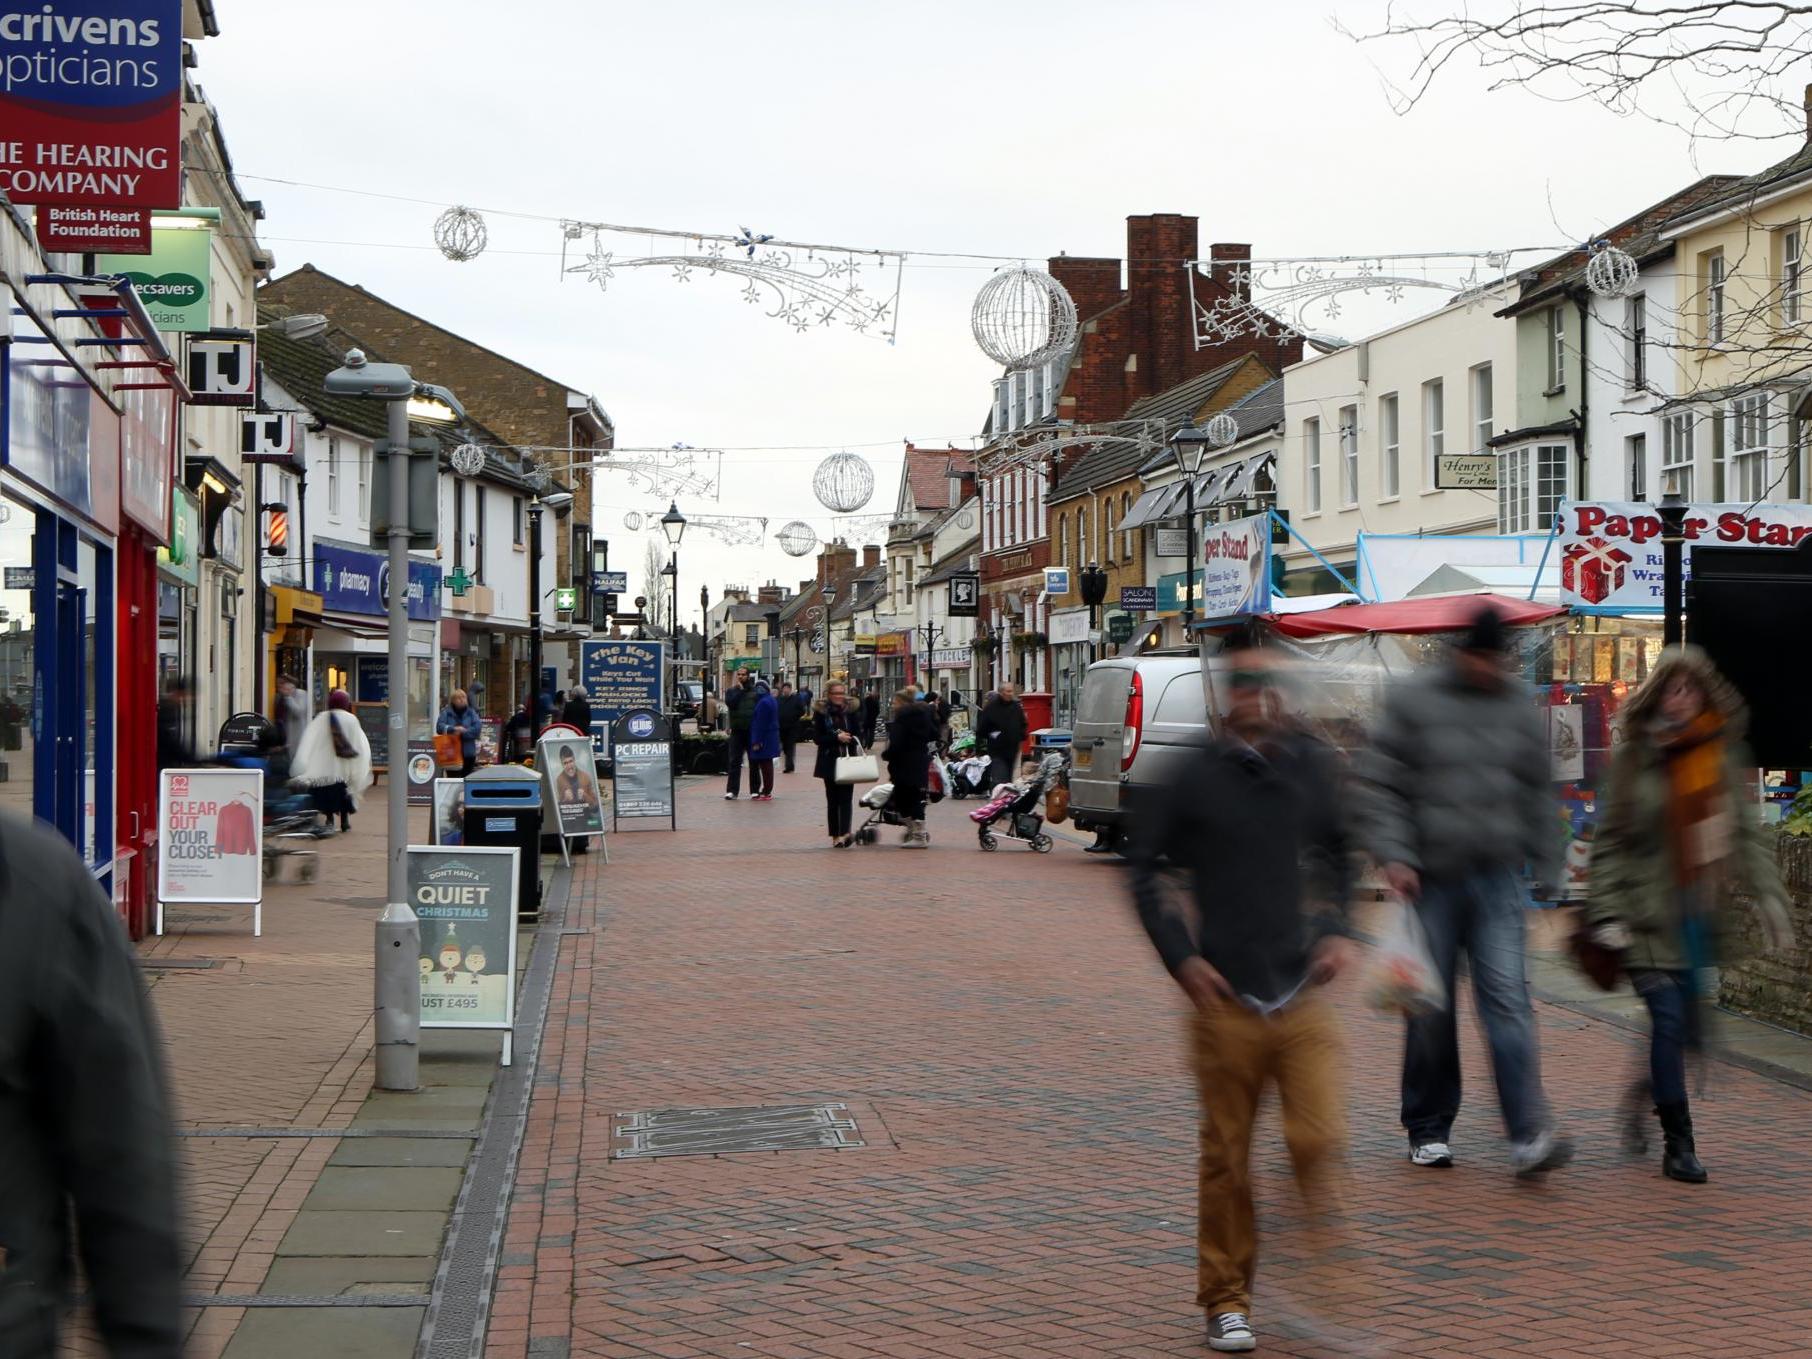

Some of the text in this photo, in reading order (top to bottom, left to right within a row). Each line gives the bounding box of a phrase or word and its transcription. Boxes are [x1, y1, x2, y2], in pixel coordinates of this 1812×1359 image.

[0, 5, 160, 46] crivens
[0, 48, 159, 92] pticians
[37, 143, 168, 170] HEARING
[50, 208, 141, 223] British Heart
[50, 223, 141, 238] Foundation
[136, 282, 195, 296] ecsavers
[152, 311, 185, 324] icians
[1443, 457, 1492, 472] Henry's
[1458, 477, 1498, 485] For Men
[1574, 506, 1708, 544] Papr
[1205, 531, 1248, 565] per Stand
[1646, 554, 1692, 566] Rio
[340, 567, 371, 596] pharmacy
[595, 578, 626, 586] HALIFAX
[1124, 589, 1152, 597] SALON
[590, 645, 656, 661] The Key
[608, 655, 639, 665] Van
[615, 743, 669, 756] PC REPAIR
[169, 800, 217, 816] CLEAR
[169, 815, 199, 830] OUT
[168, 830, 208, 845] YOUR
[168, 844, 225, 860] CLOSET
[429, 869, 452, 880] DON'T
[453, 870, 473, 879] HAVE
[416, 886, 490, 905] QUIET
[416, 907, 489, 918] CHRISTMAS
[422, 998, 478, 1009] UST £495
